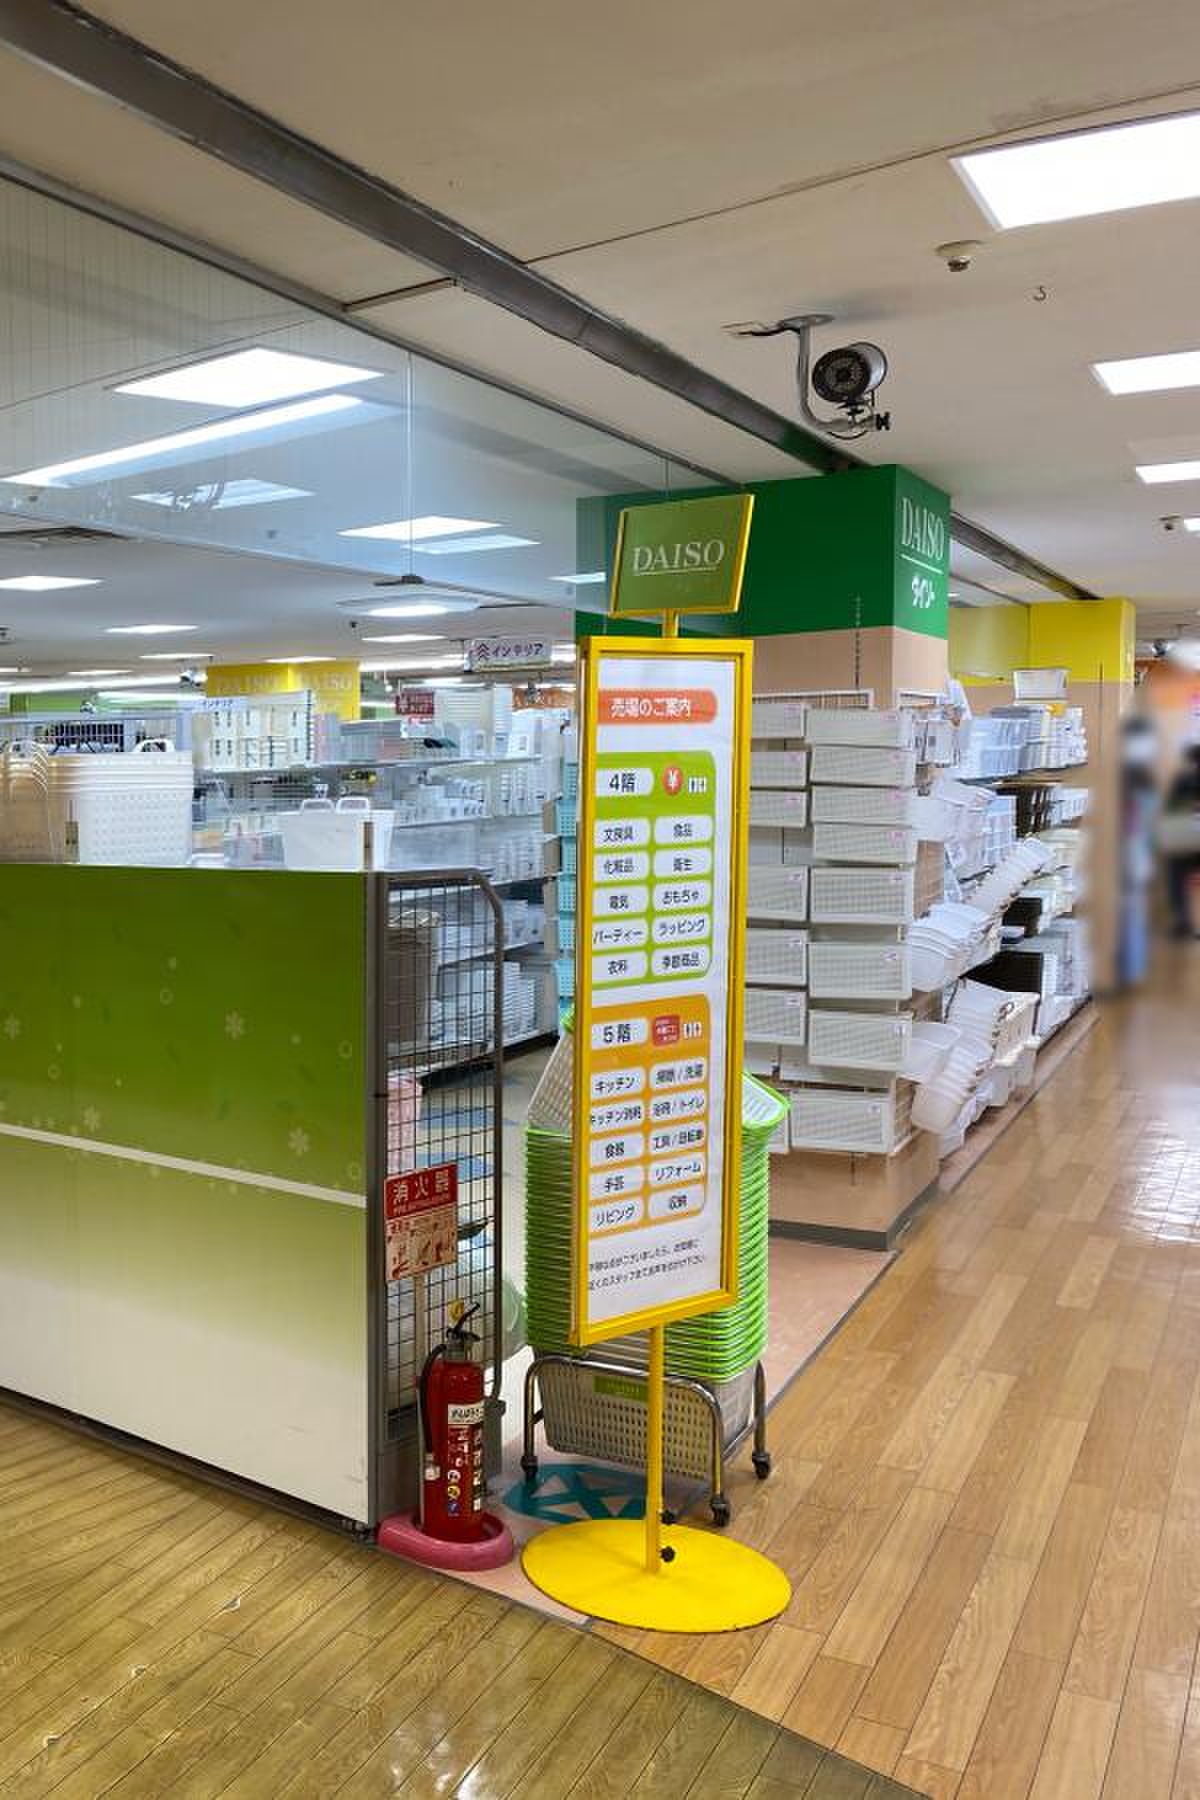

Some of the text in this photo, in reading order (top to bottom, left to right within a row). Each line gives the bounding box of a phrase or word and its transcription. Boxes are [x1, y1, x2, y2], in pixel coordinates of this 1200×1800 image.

[901, 497, 945, 561] DAISO
[633, 540, 725, 572] DAISO
[610, 698, 691, 718] 売場のご案内
[608, 773, 636, 792] 4階
[603, 858, 635, 875] 化粧品
[662, 889, 700, 905] おもちゃ
[659, 918, 706, 937] ラッピング
[603, 1023, 632, 1044] 5階
[595, 1077, 636, 1093] キッチン
[655, 1161, 702, 1181] リフォーム
[393, 1169, 449, 1206] 消火器
[596, 1203, 636, 1227] リビング
